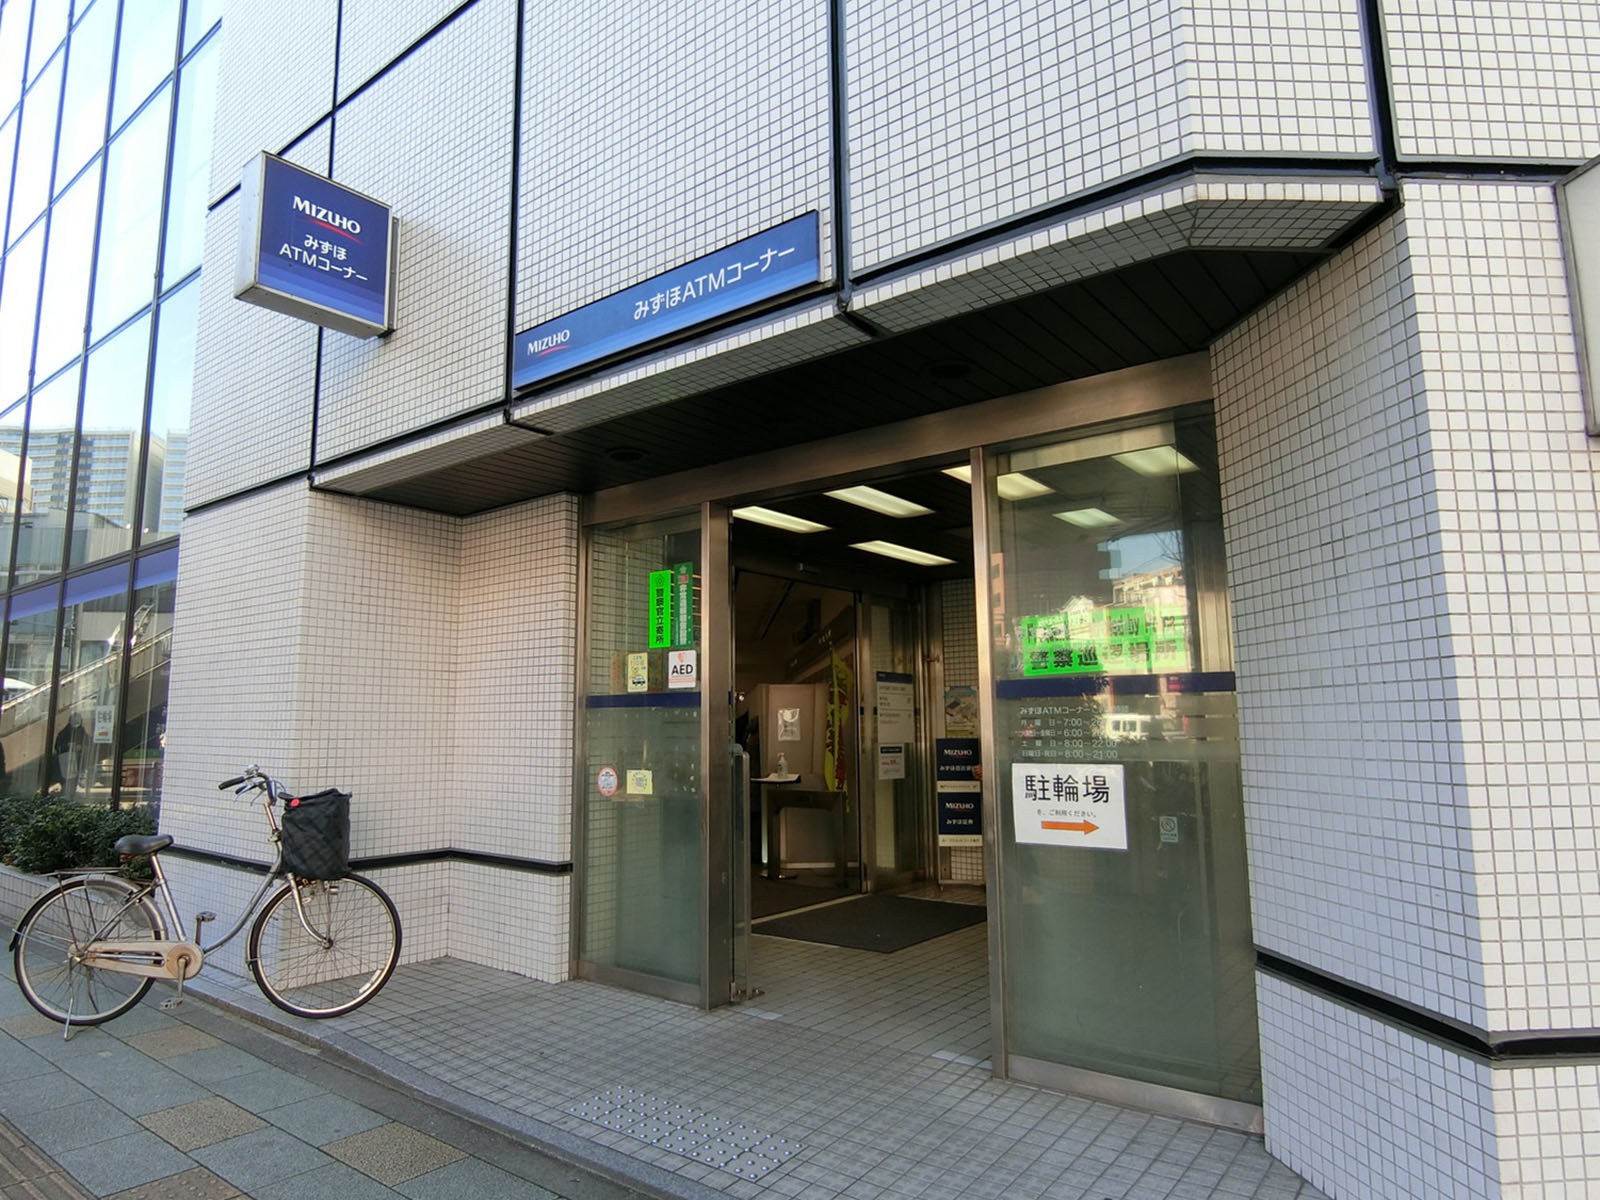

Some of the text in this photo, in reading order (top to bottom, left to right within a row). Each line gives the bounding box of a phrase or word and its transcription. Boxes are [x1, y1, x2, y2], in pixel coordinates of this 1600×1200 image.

[293, 195, 361, 235] MIZUHO
[304, 234, 347, 260] みずほ
[279, 243, 368, 281] ATMコーナー
[633, 247, 795, 320] みずほATMコーナー
[527, 329, 570, 356] MIZUHO
[671, 664, 693, 675] AED
[1024, 774, 1109, 803] 駐輪場
